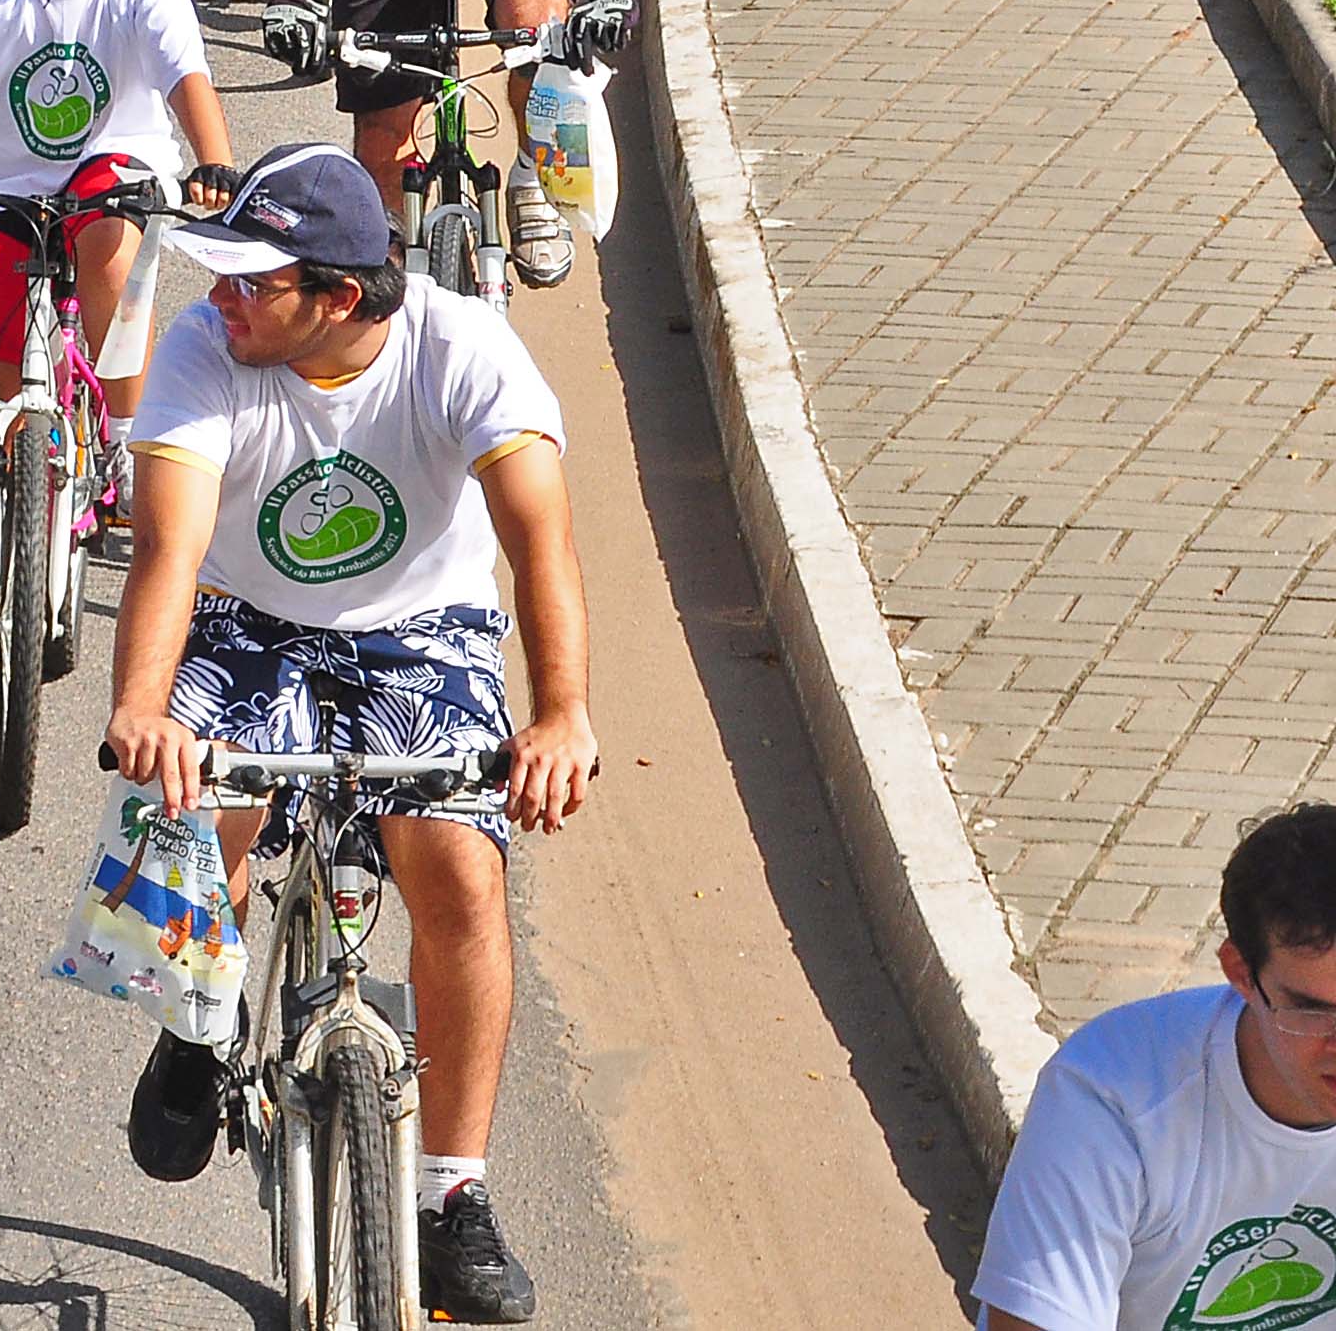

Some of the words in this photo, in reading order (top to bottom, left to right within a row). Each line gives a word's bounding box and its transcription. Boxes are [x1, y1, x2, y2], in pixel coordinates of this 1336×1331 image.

[16, 70, 27, 81] II
[24, 45, 66, 74] Passio
[266, 496, 280, 510] II
[334, 456, 396, 507] iclistico
[308, 566, 337, 580] Meio
[338, 549, 387, 575] Ambiente
[384, 531, 400, 553] 2012
[148, 832, 189, 858] Verão
[1184, 1275, 1204, 1291] II
[1289, 1206, 1336, 1241] Ciclis
